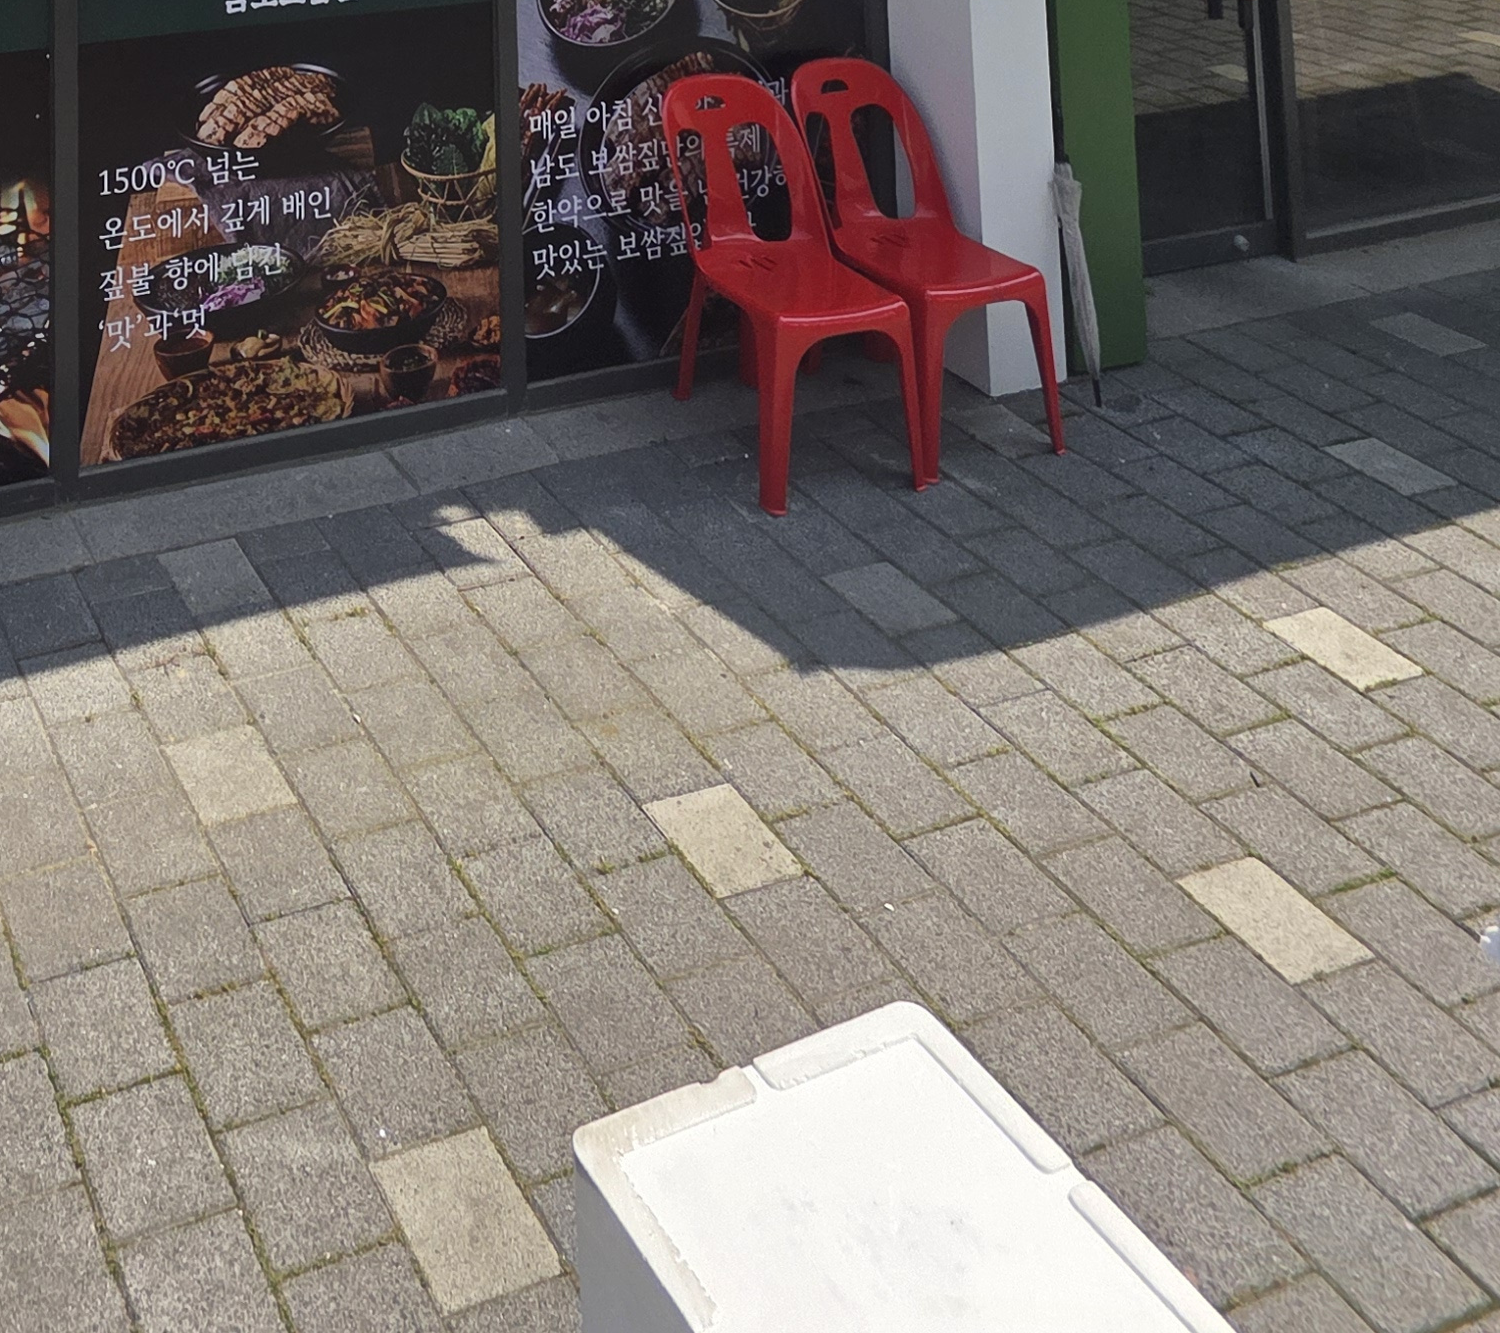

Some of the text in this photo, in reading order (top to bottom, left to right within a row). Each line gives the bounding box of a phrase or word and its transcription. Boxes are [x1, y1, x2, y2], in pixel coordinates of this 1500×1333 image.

[529, 106, 578, 140] 매일
[586, 98, 633, 132] 아침
[207, 151, 260, 186] 넘는
[530, 153, 580, 188] 남도
[98, 187, 332, 252] 온도에서 깊게 배인
[531, 189, 631, 234] 한약으로
[99, 263, 155, 302] 짚불
[164, 252, 221, 291] 향에
[533, 239, 607, 280] 맛있는
